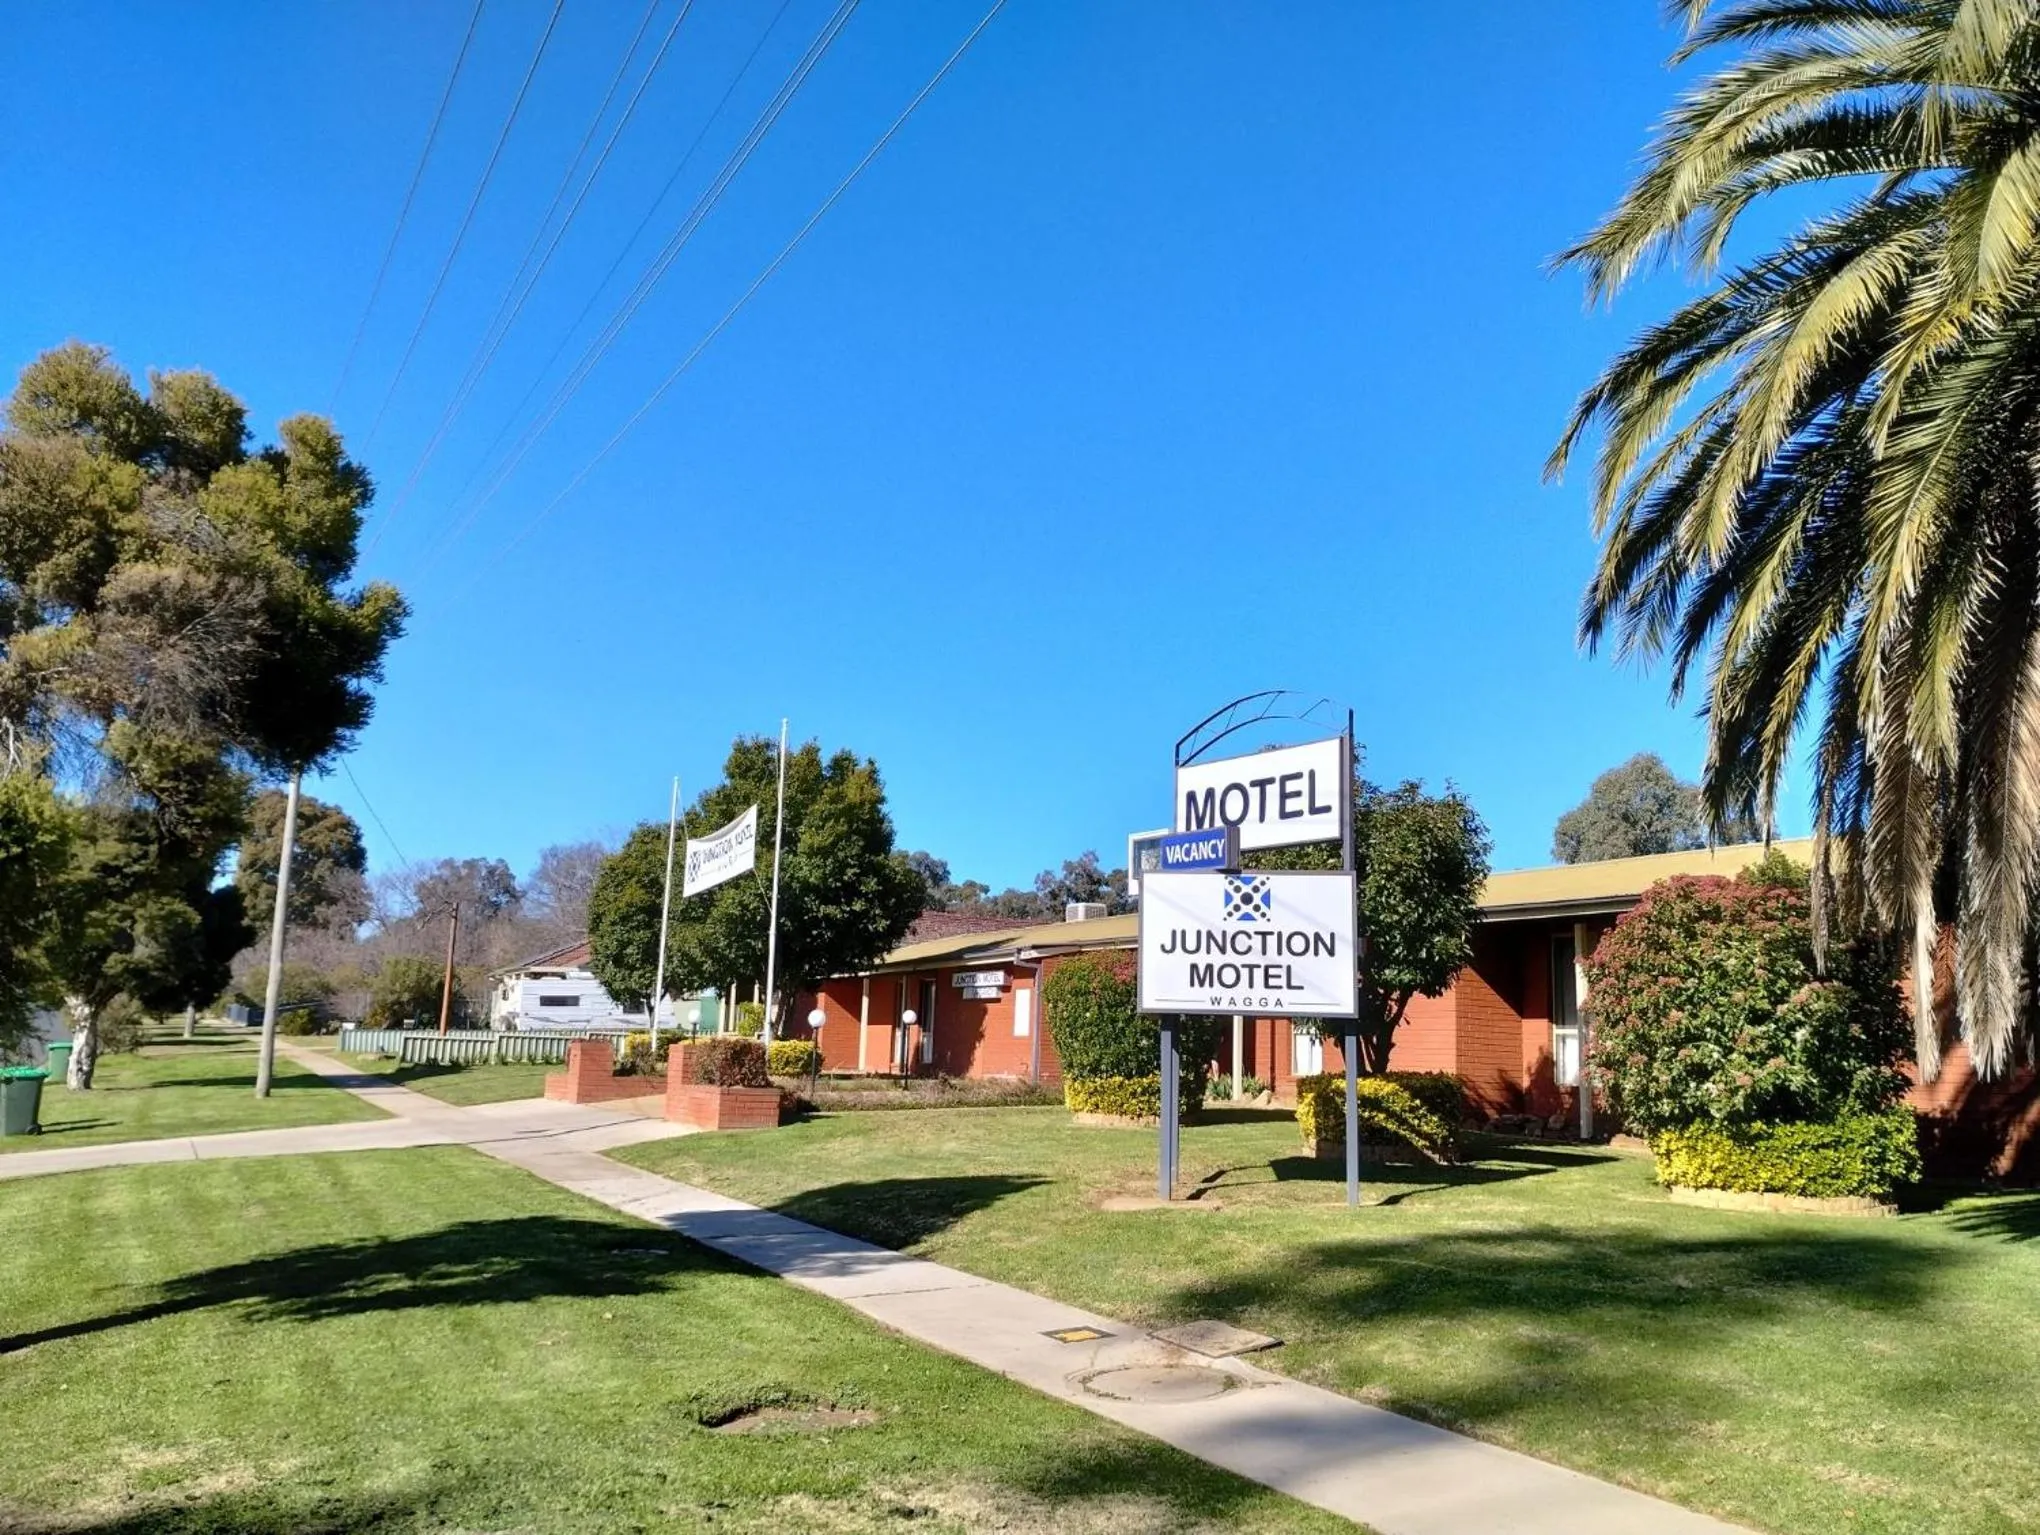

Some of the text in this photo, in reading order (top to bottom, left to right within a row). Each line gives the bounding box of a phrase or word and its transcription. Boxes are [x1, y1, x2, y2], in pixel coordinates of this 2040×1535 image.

[1185, 769, 1332, 832] MOTEL
[1166, 837, 1225, 865] VACANCY
[1160, 928, 1336, 958] JUNCTION
[1189, 963, 1305, 991] MOTEL
[1210, 995, 1284, 1009] WAGGA
